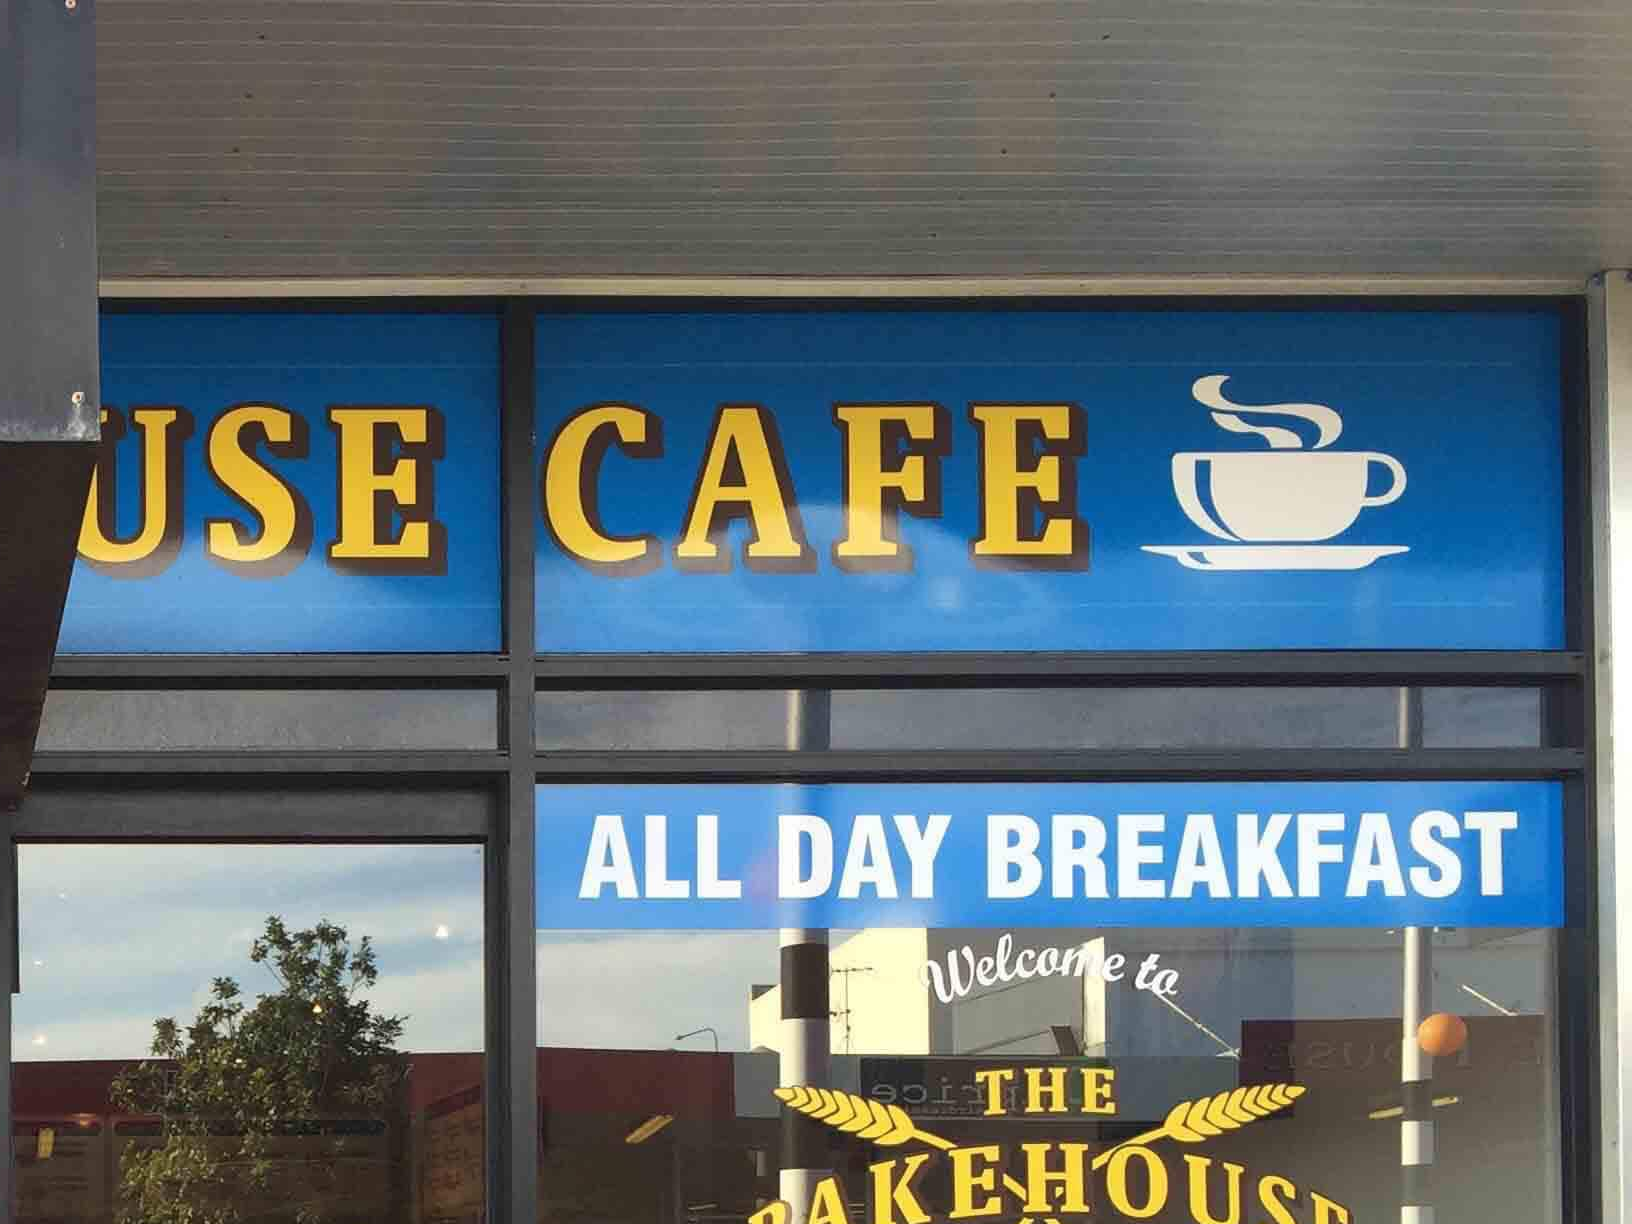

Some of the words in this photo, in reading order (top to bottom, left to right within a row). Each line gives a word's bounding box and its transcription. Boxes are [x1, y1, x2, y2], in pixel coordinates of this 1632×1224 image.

[545, 406, 1073, 561] CAFE
[579, 814, 742, 899] ALL
[778, 814, 951, 898] DAY
[986, 811, 1517, 898] BREAKFAST
[917, 932, 1126, 1005] Welcome
[1133, 951, 1180, 997] to
[975, 1067, 1116, 1117] THE
